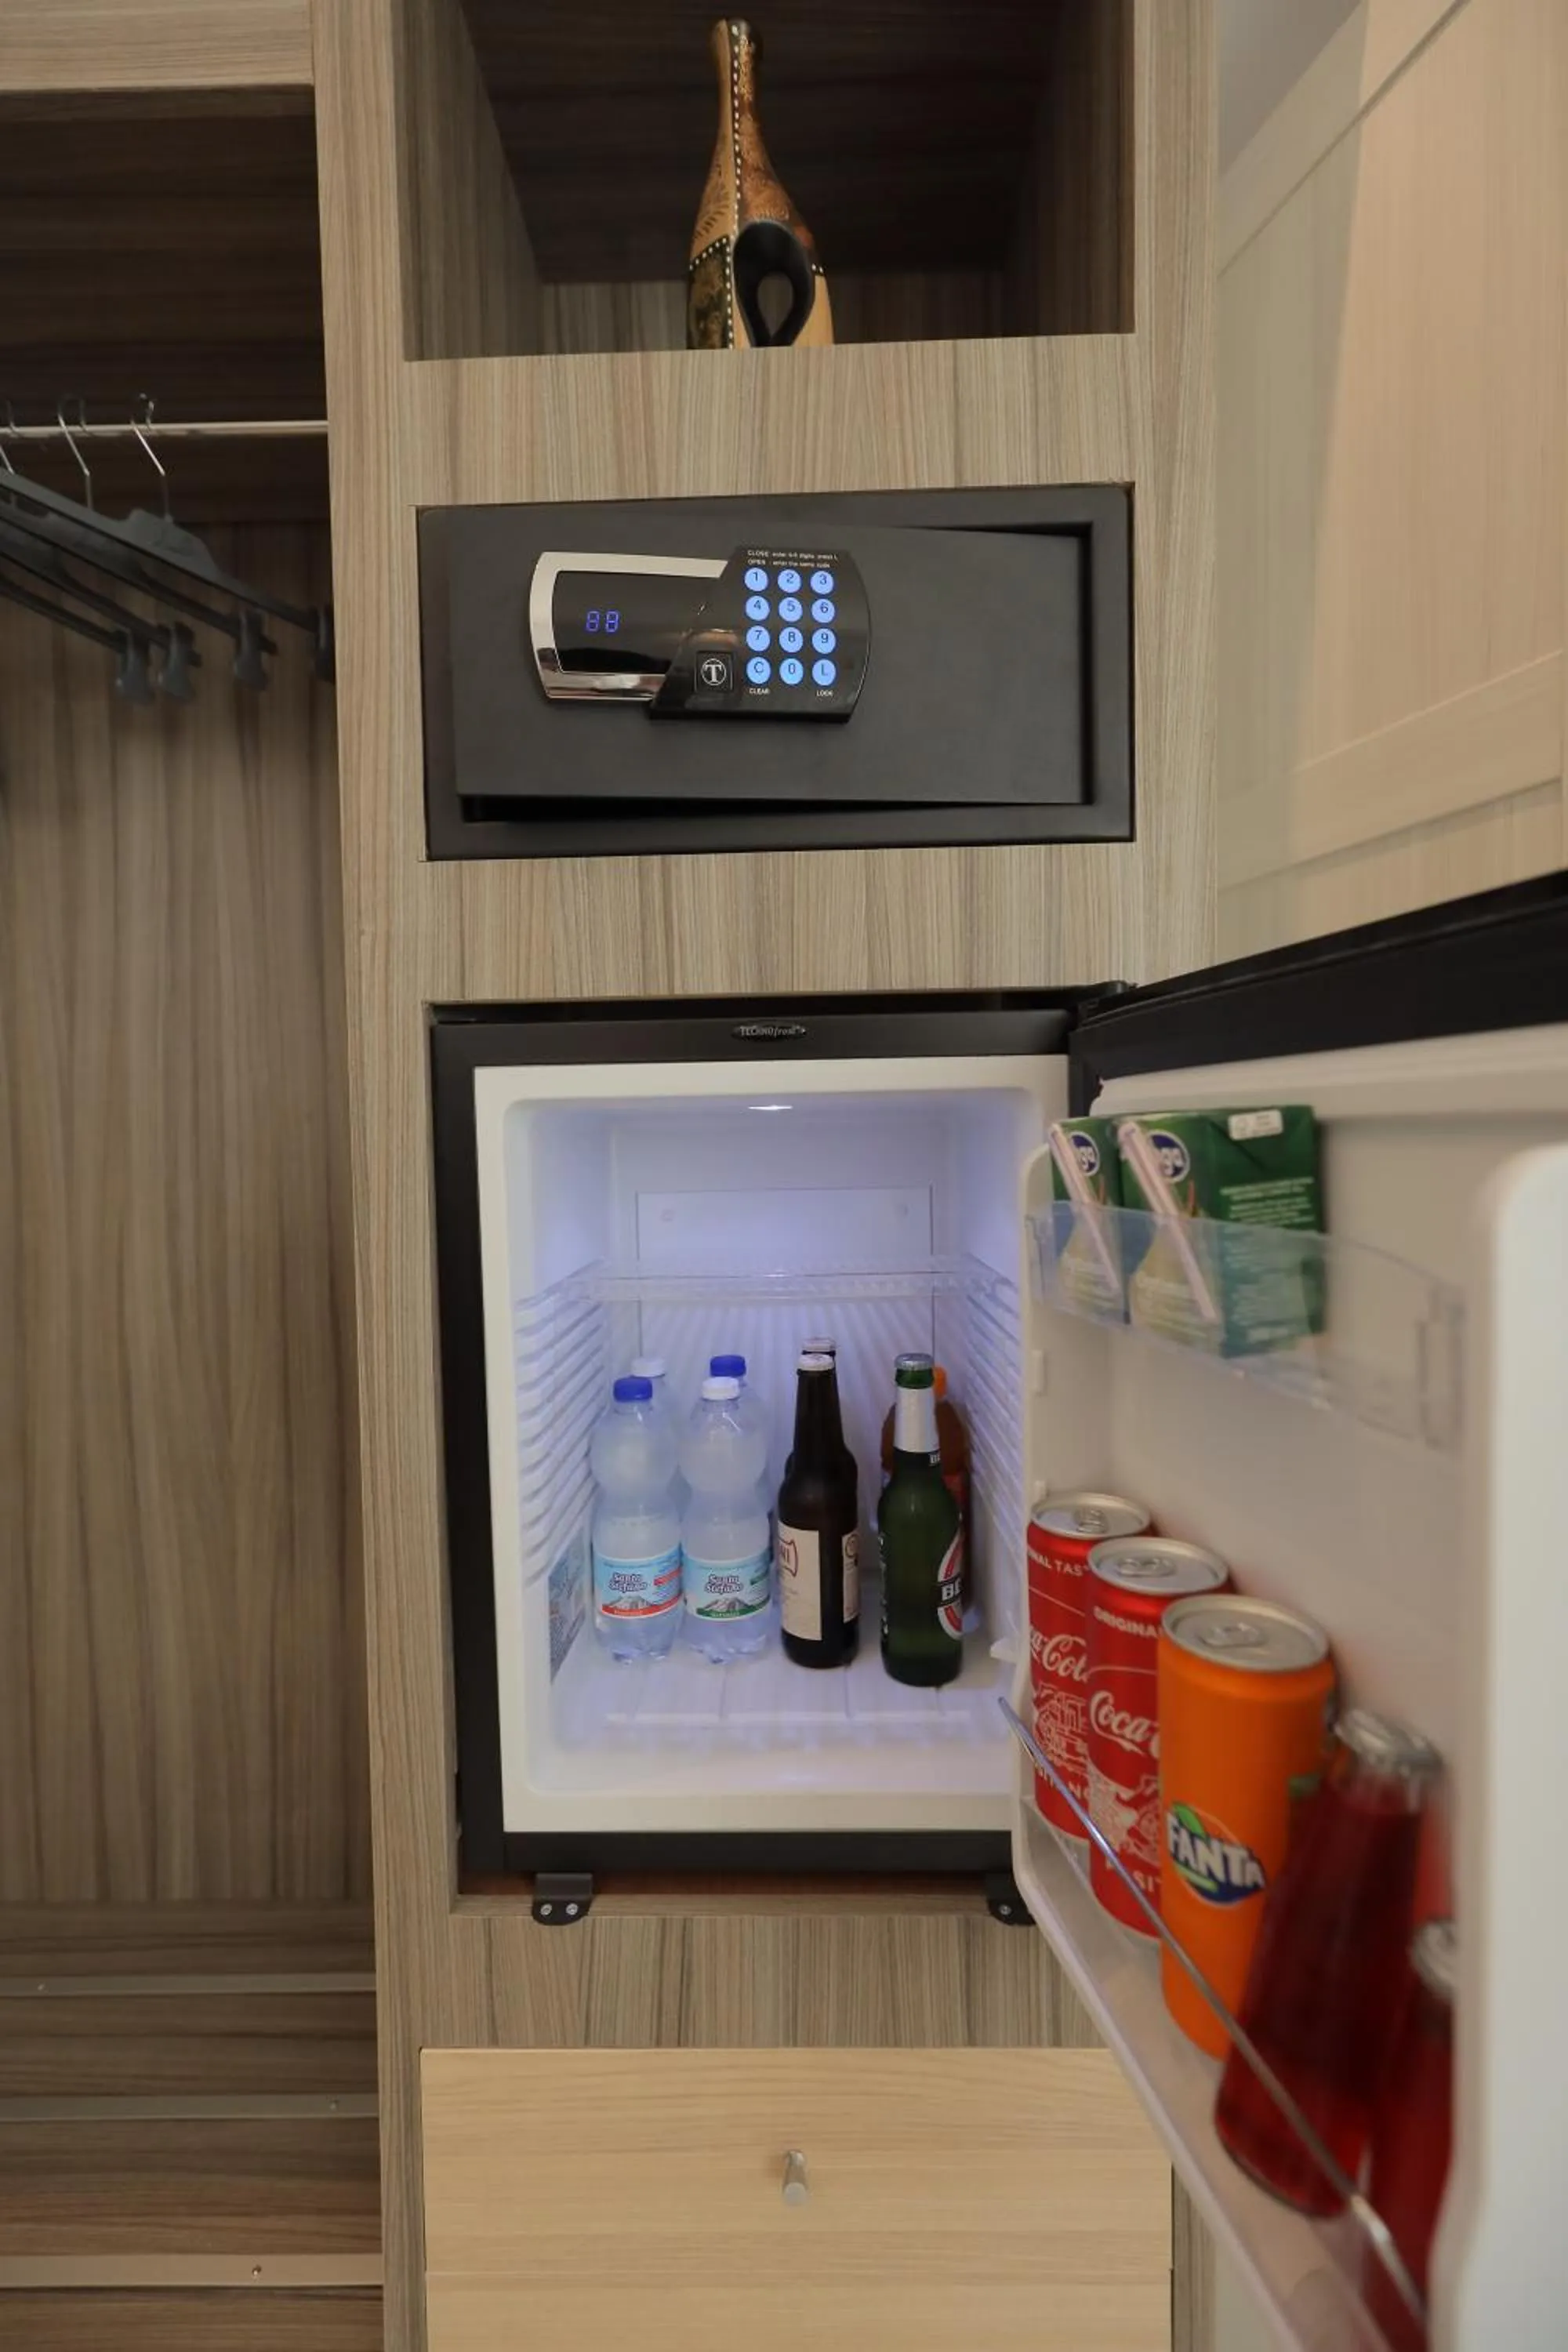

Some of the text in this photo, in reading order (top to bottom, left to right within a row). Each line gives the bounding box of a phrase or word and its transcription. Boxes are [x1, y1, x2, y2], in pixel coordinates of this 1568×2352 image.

[753, 572, 827, 585] 1 2 3
[753, 600, 829, 613] 4 5 6
[755, 630, 829, 644] 7 8 9
[753, 661, 764, 673] C
[821, 664, 829, 676] L
[1167, 1812, 1265, 1888] FANTA
